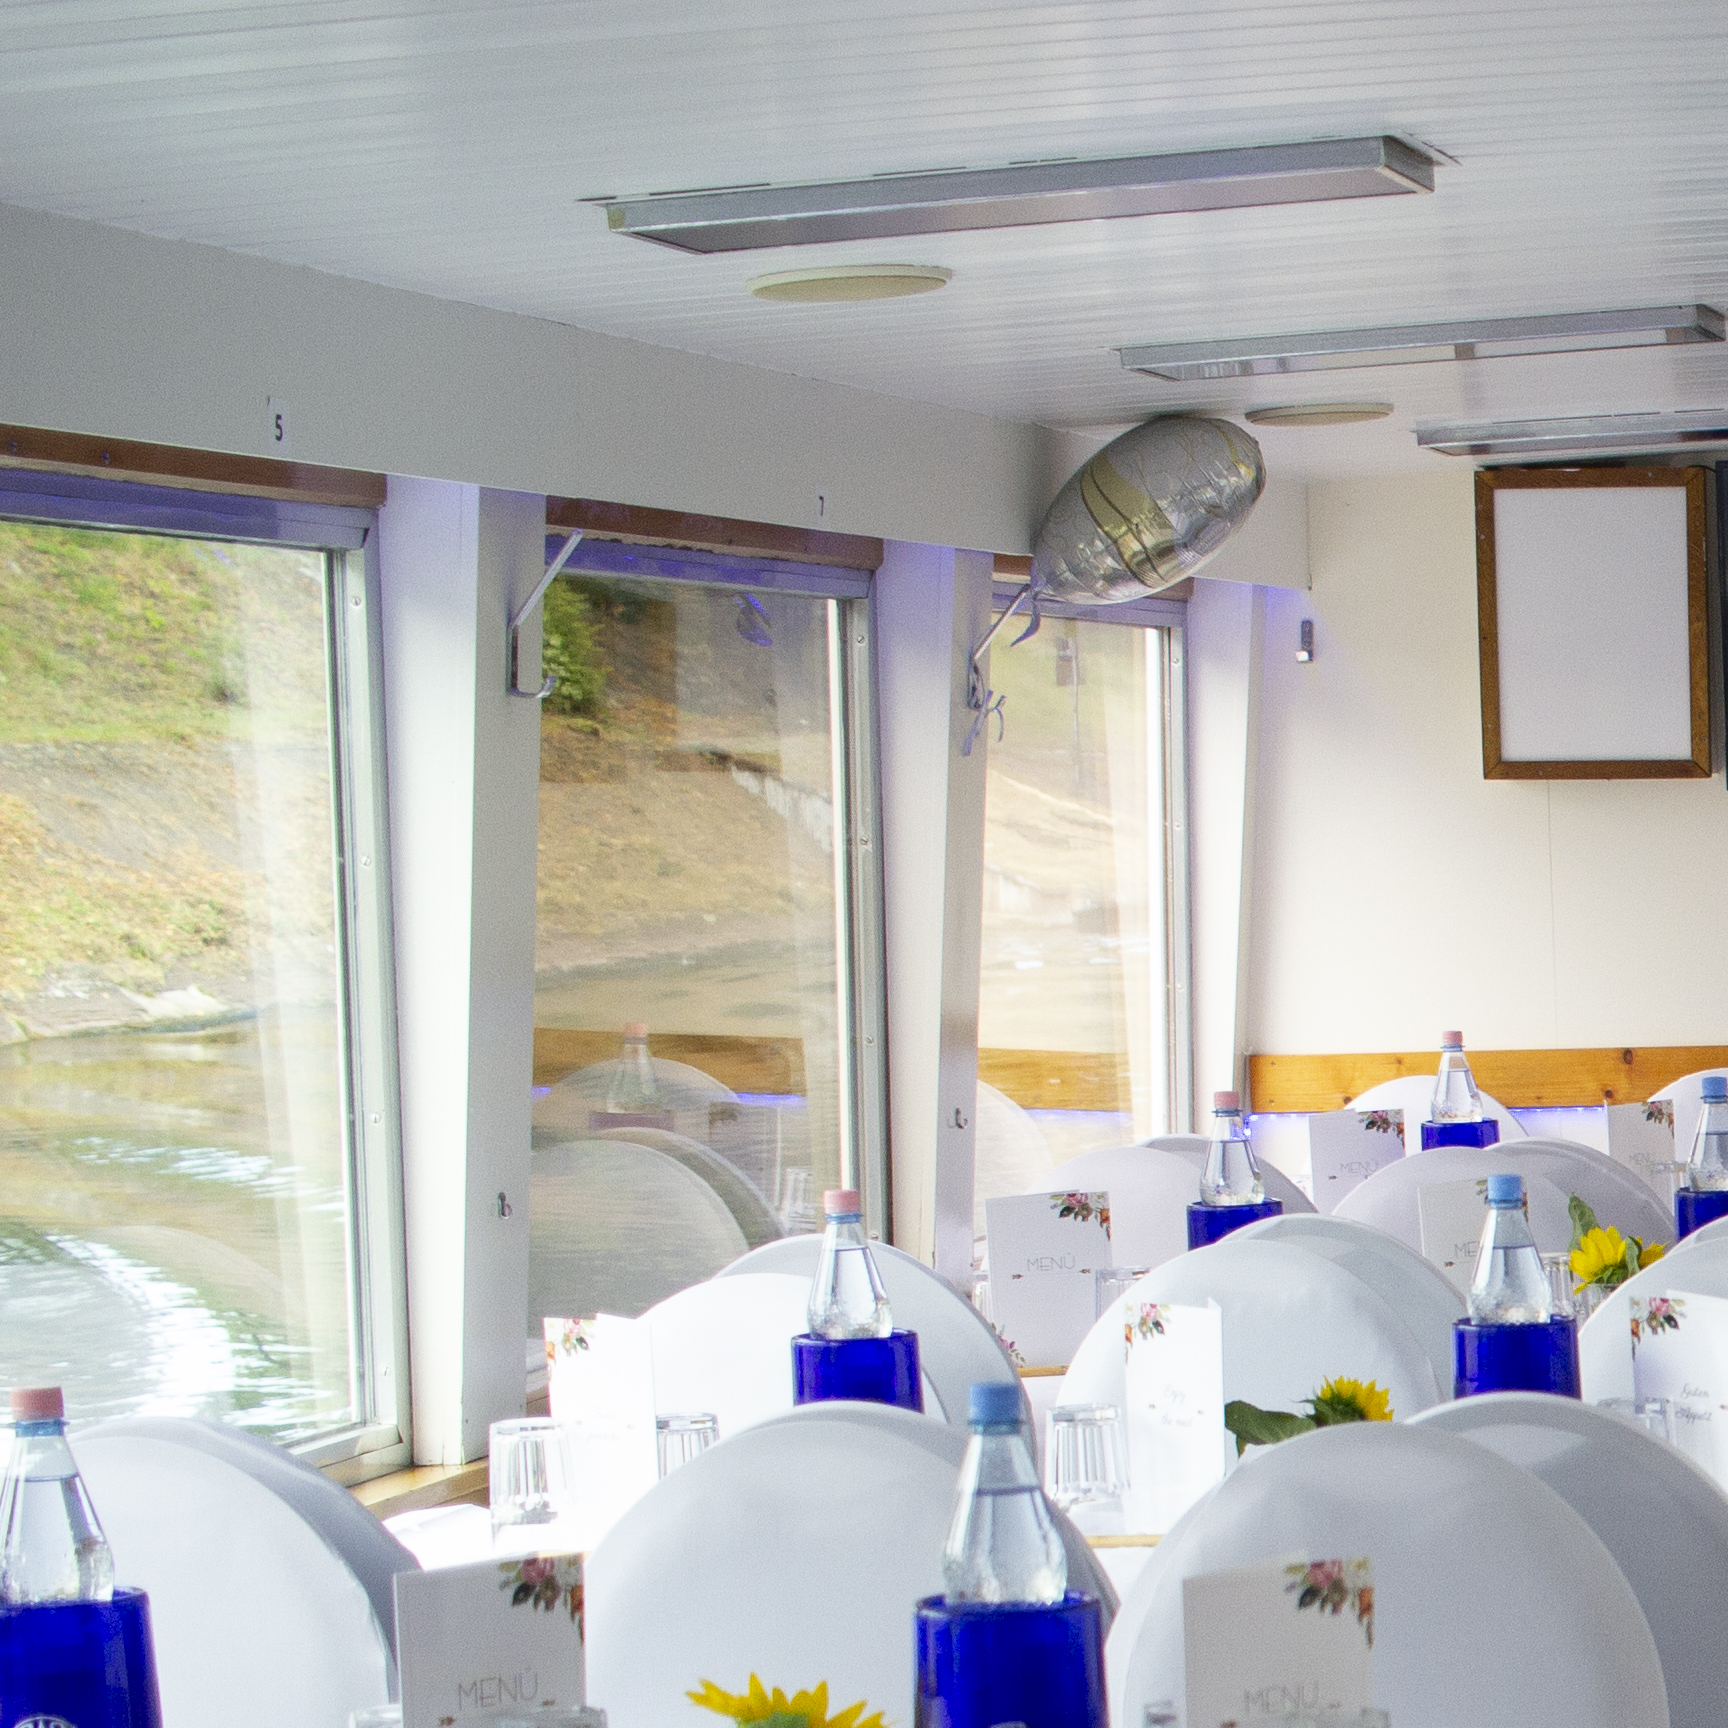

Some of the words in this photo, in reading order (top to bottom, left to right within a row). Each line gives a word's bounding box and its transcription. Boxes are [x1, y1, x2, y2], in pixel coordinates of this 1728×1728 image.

[275, 413, 283, 441] 5
[1026, 1252, 1076, 1272] MENÜ
[458, 1666, 539, 1711] MENÜ
